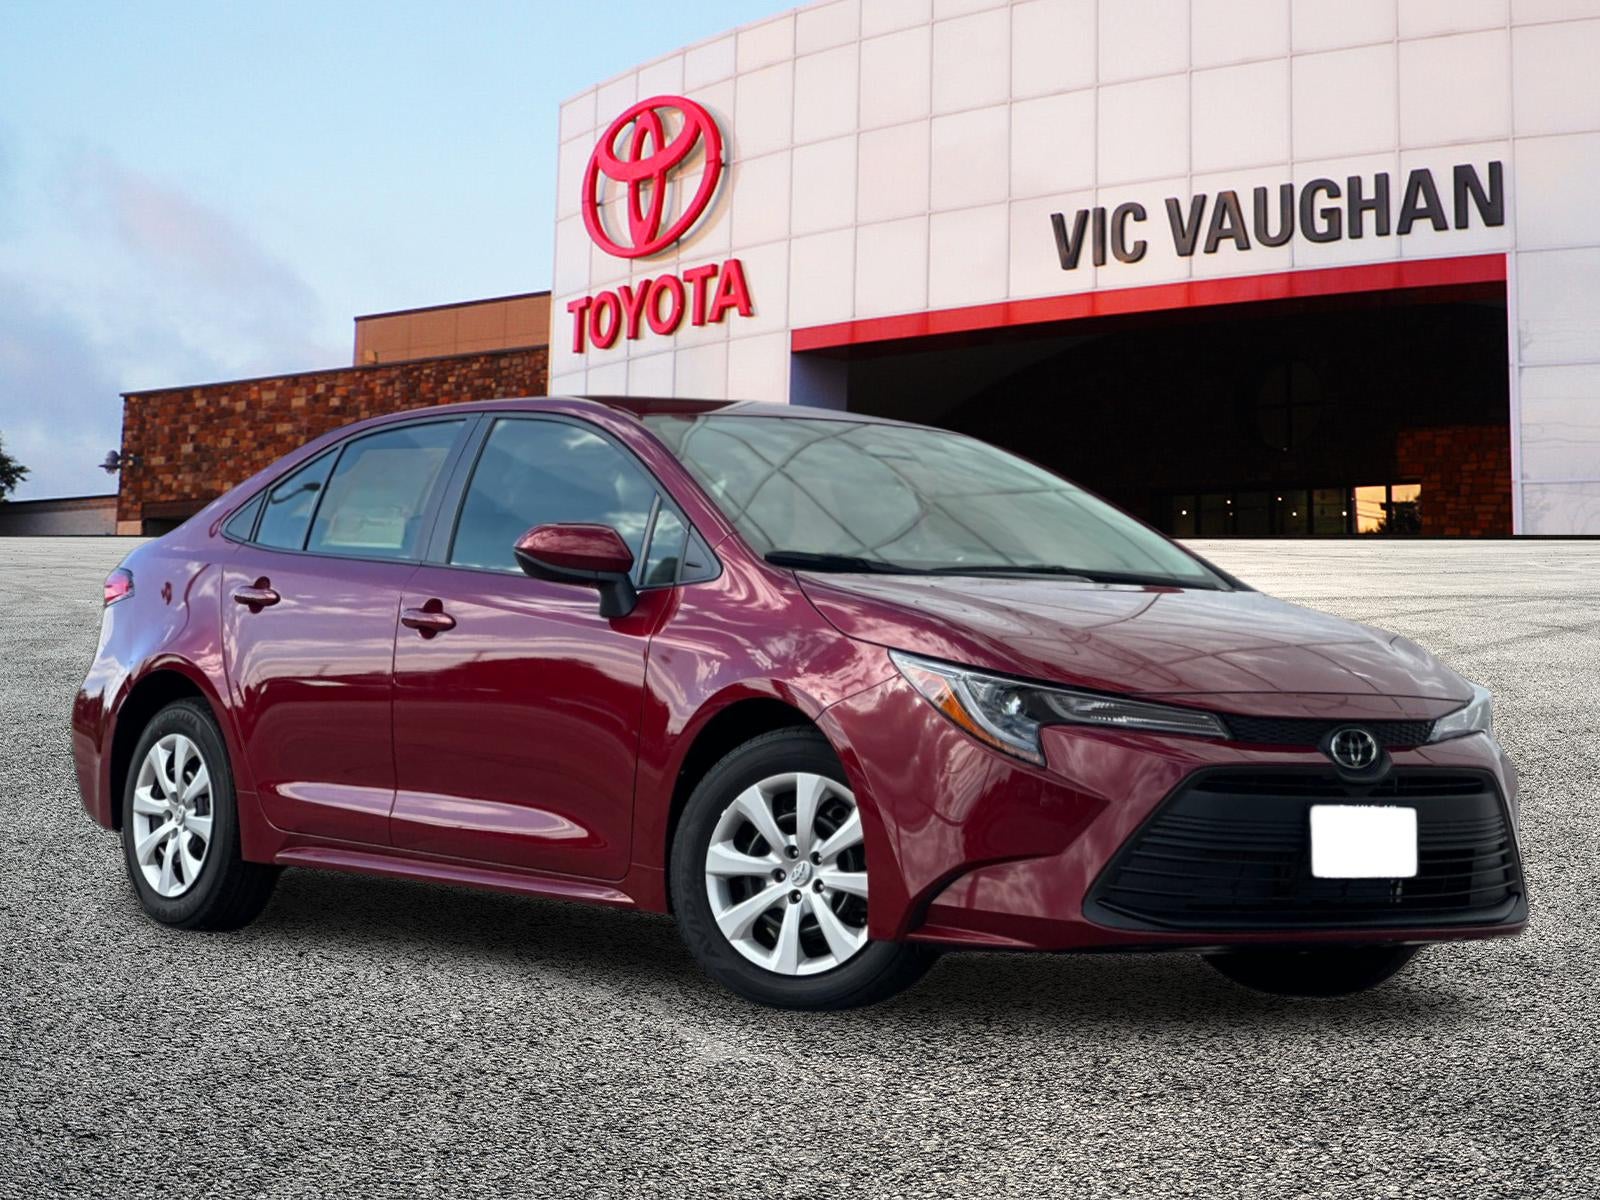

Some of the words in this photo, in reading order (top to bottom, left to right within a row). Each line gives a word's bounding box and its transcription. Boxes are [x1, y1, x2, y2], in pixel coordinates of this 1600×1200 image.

[1051, 202, 1147, 270] VIC
[1165, 161, 1504, 257] VAUGHAN
[567, 259, 753, 353] TOYOTA
